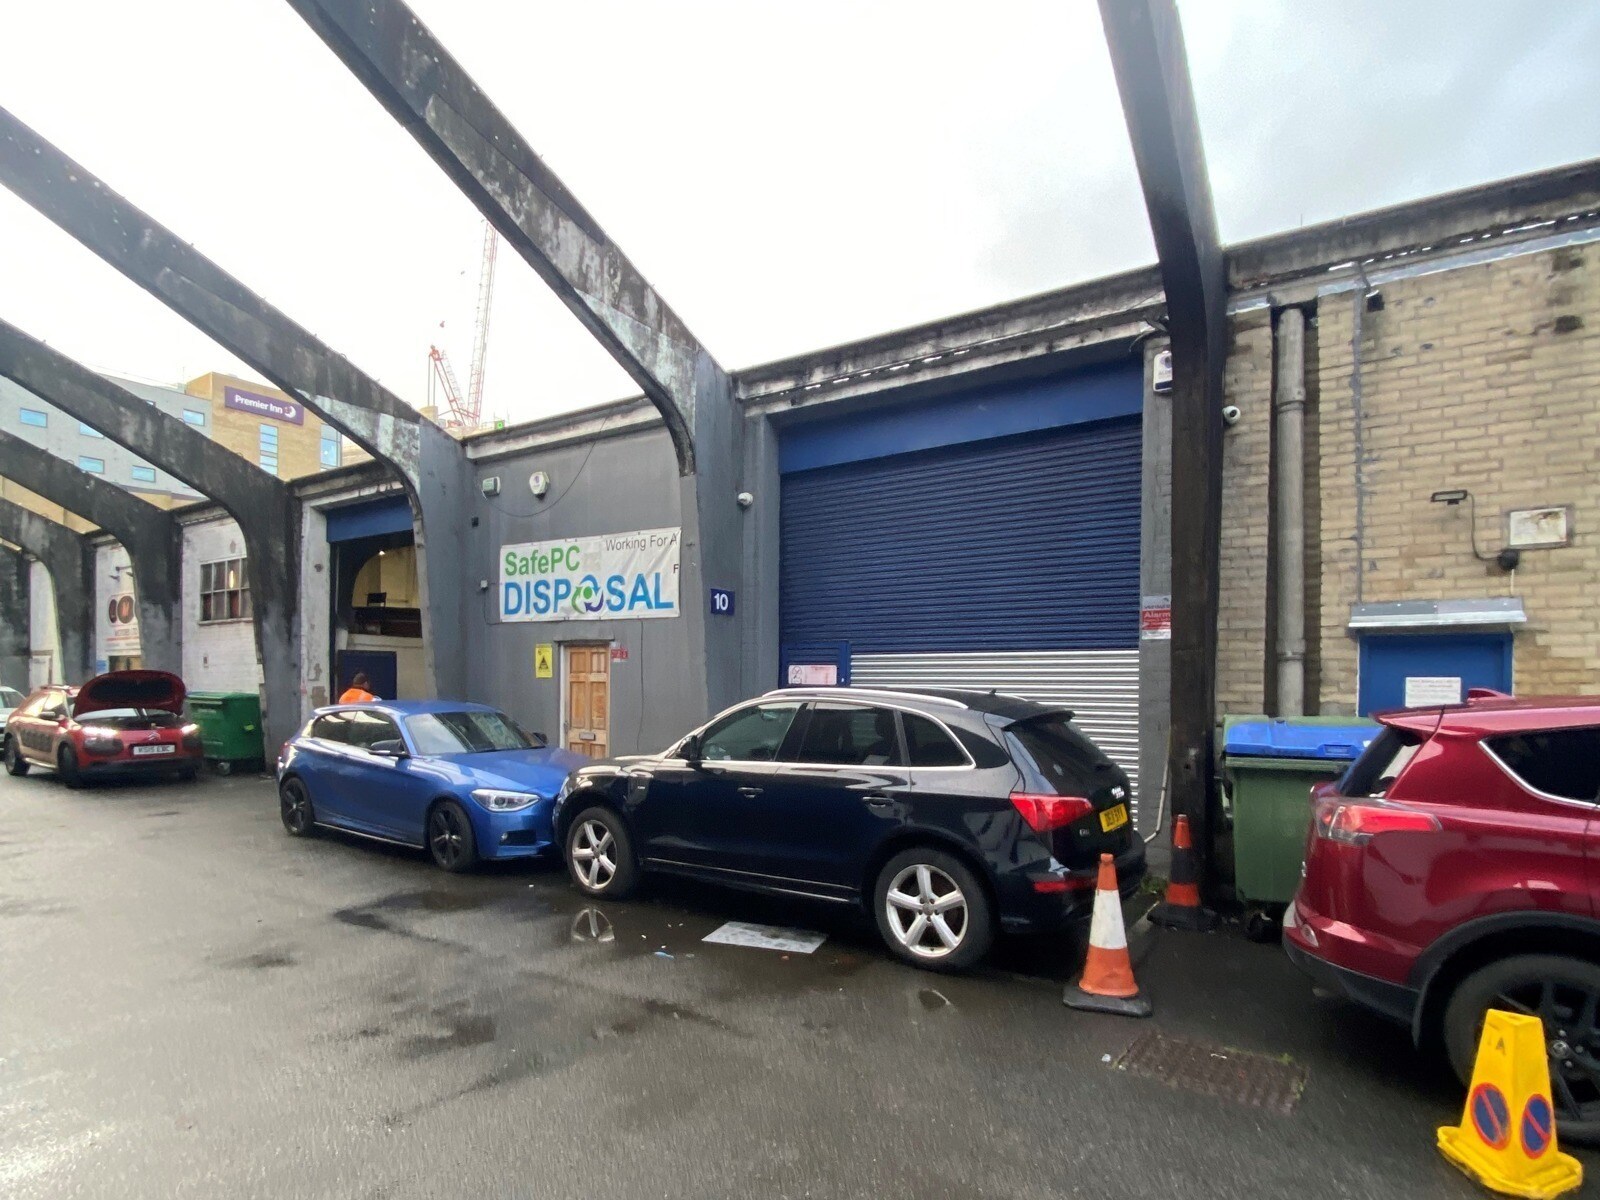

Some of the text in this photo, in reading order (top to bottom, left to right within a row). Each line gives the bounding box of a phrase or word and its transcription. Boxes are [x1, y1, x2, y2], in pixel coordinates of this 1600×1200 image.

[234, 394, 283, 414] Premier Inn
[606, 537, 647, 552] Working
[650, 535, 669, 548] For
[505, 545, 580, 576] SafePC
[714, 593, 729, 611] 10
